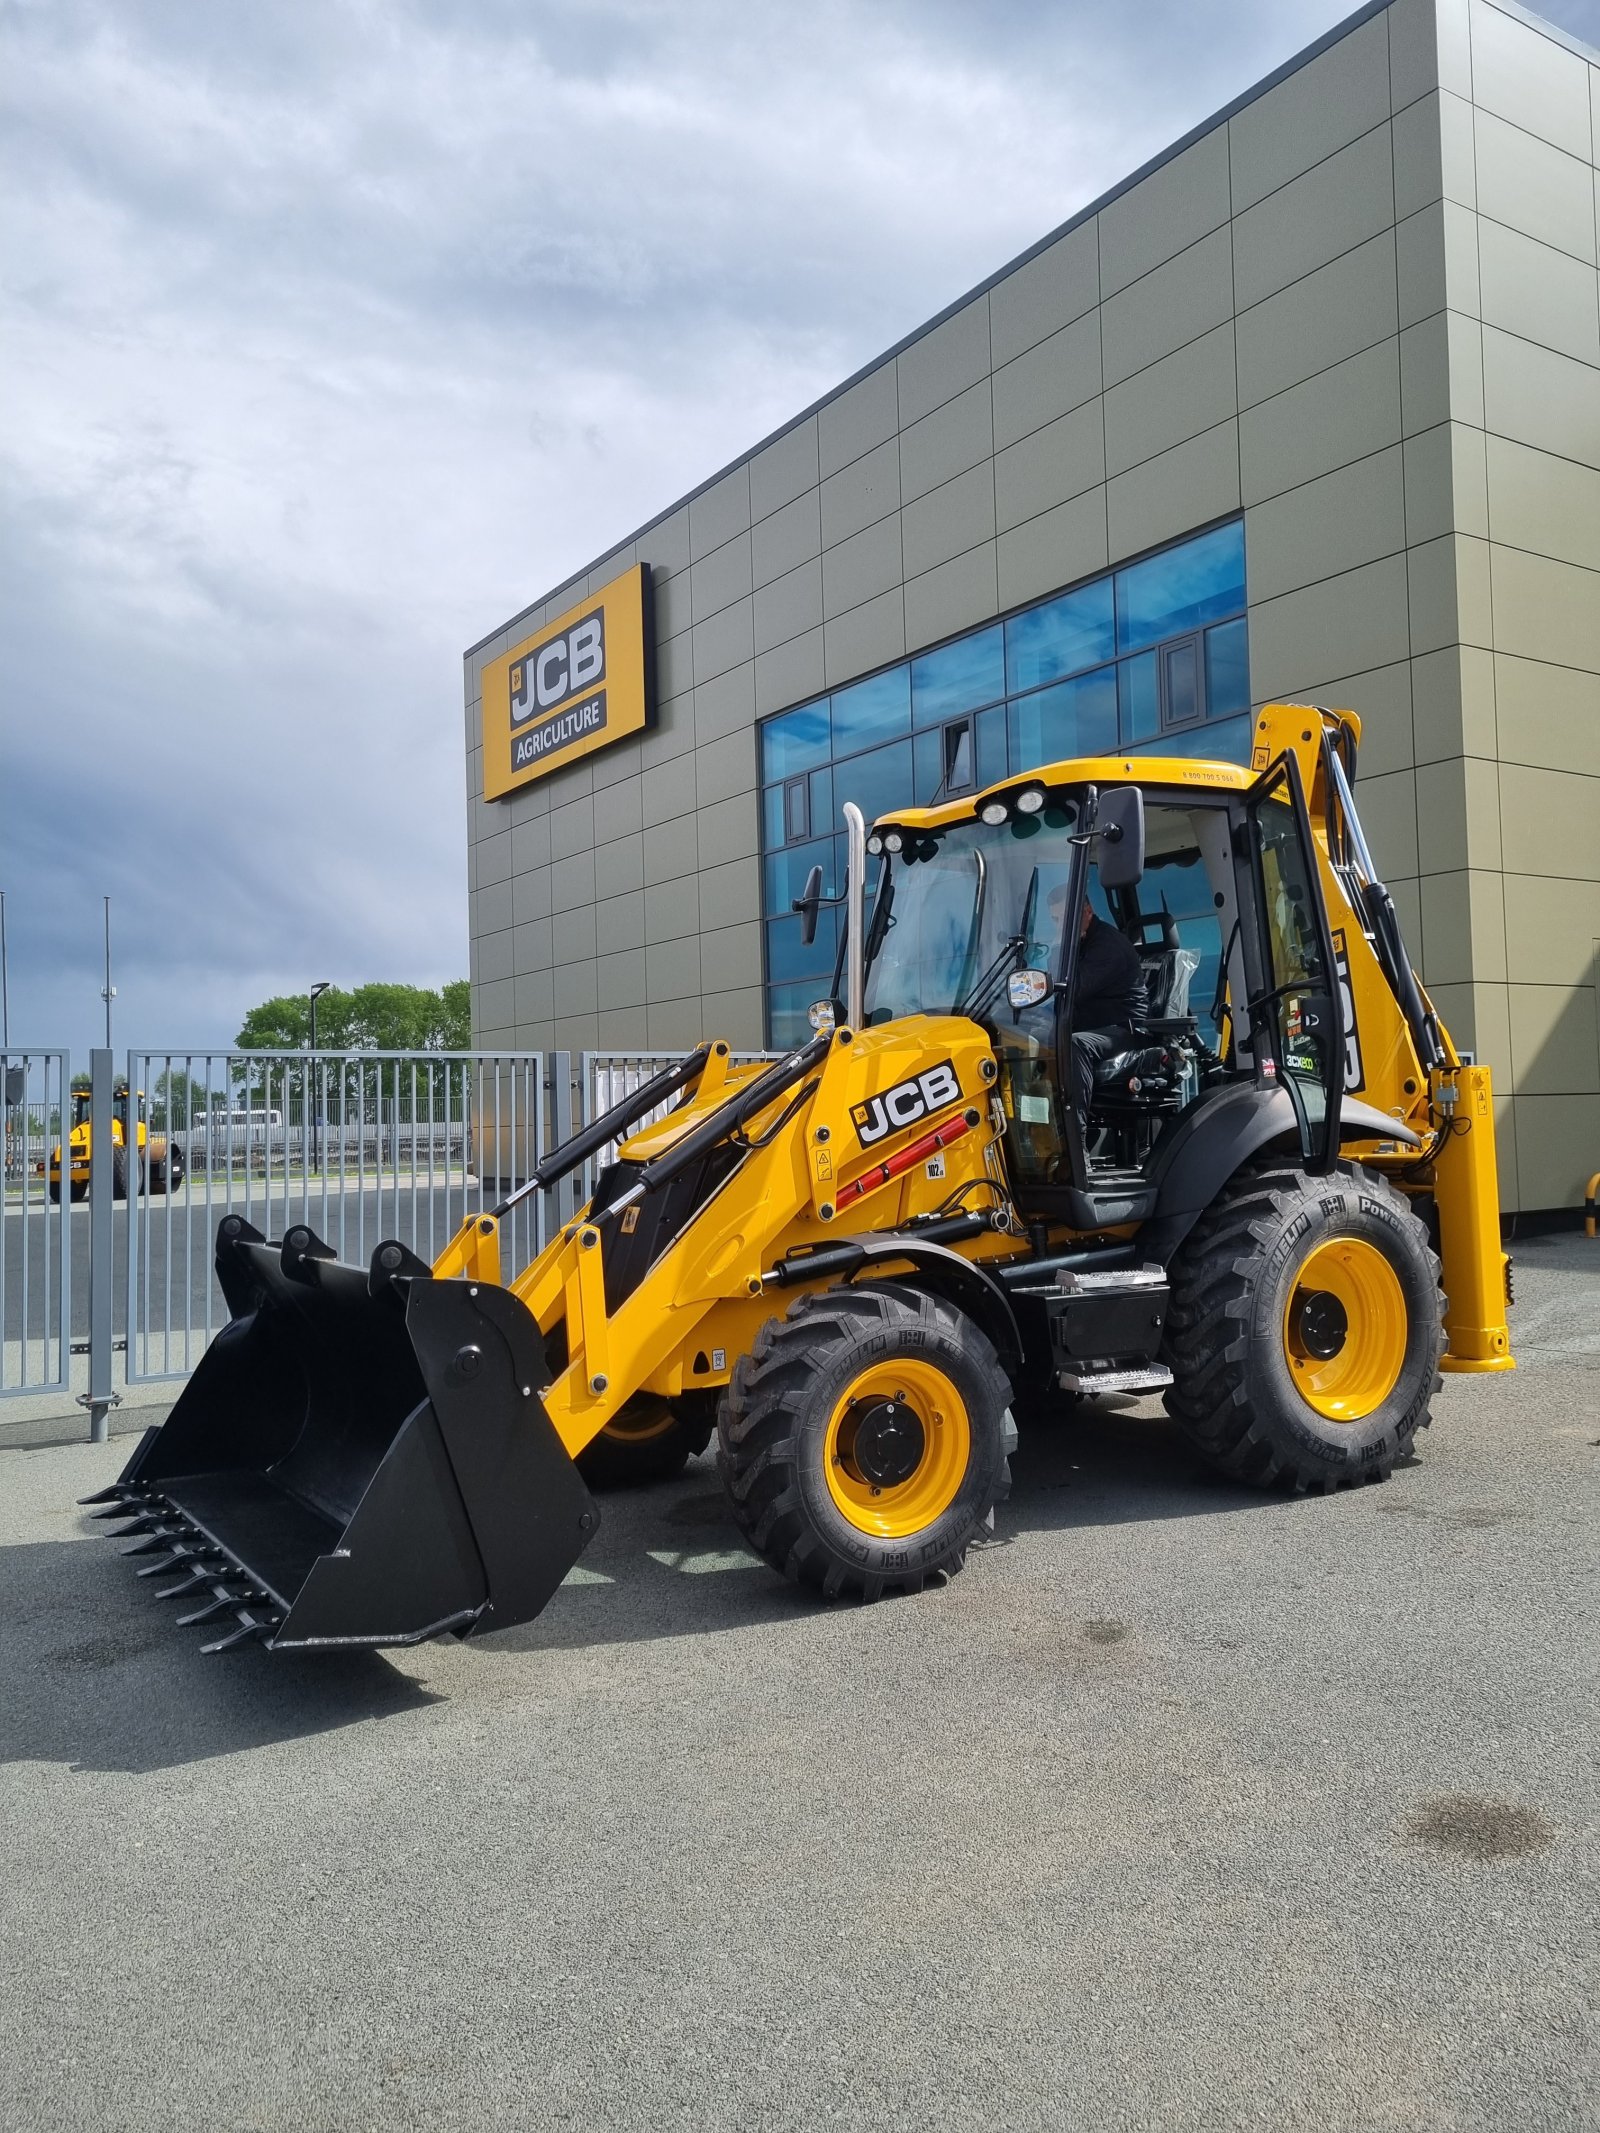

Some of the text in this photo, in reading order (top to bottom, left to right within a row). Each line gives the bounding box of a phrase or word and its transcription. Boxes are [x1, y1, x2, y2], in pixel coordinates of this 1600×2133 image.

[512, 618, 603, 721] JCB
[516, 701, 600, 763] AGRICULTURE
[860, 1065, 959, 1142] JCB
[928, 1164, 939, 1177] 102
[1361, 1198, 1403, 1233] Power
[1260, 1213, 1309, 1306] MICHELIN
